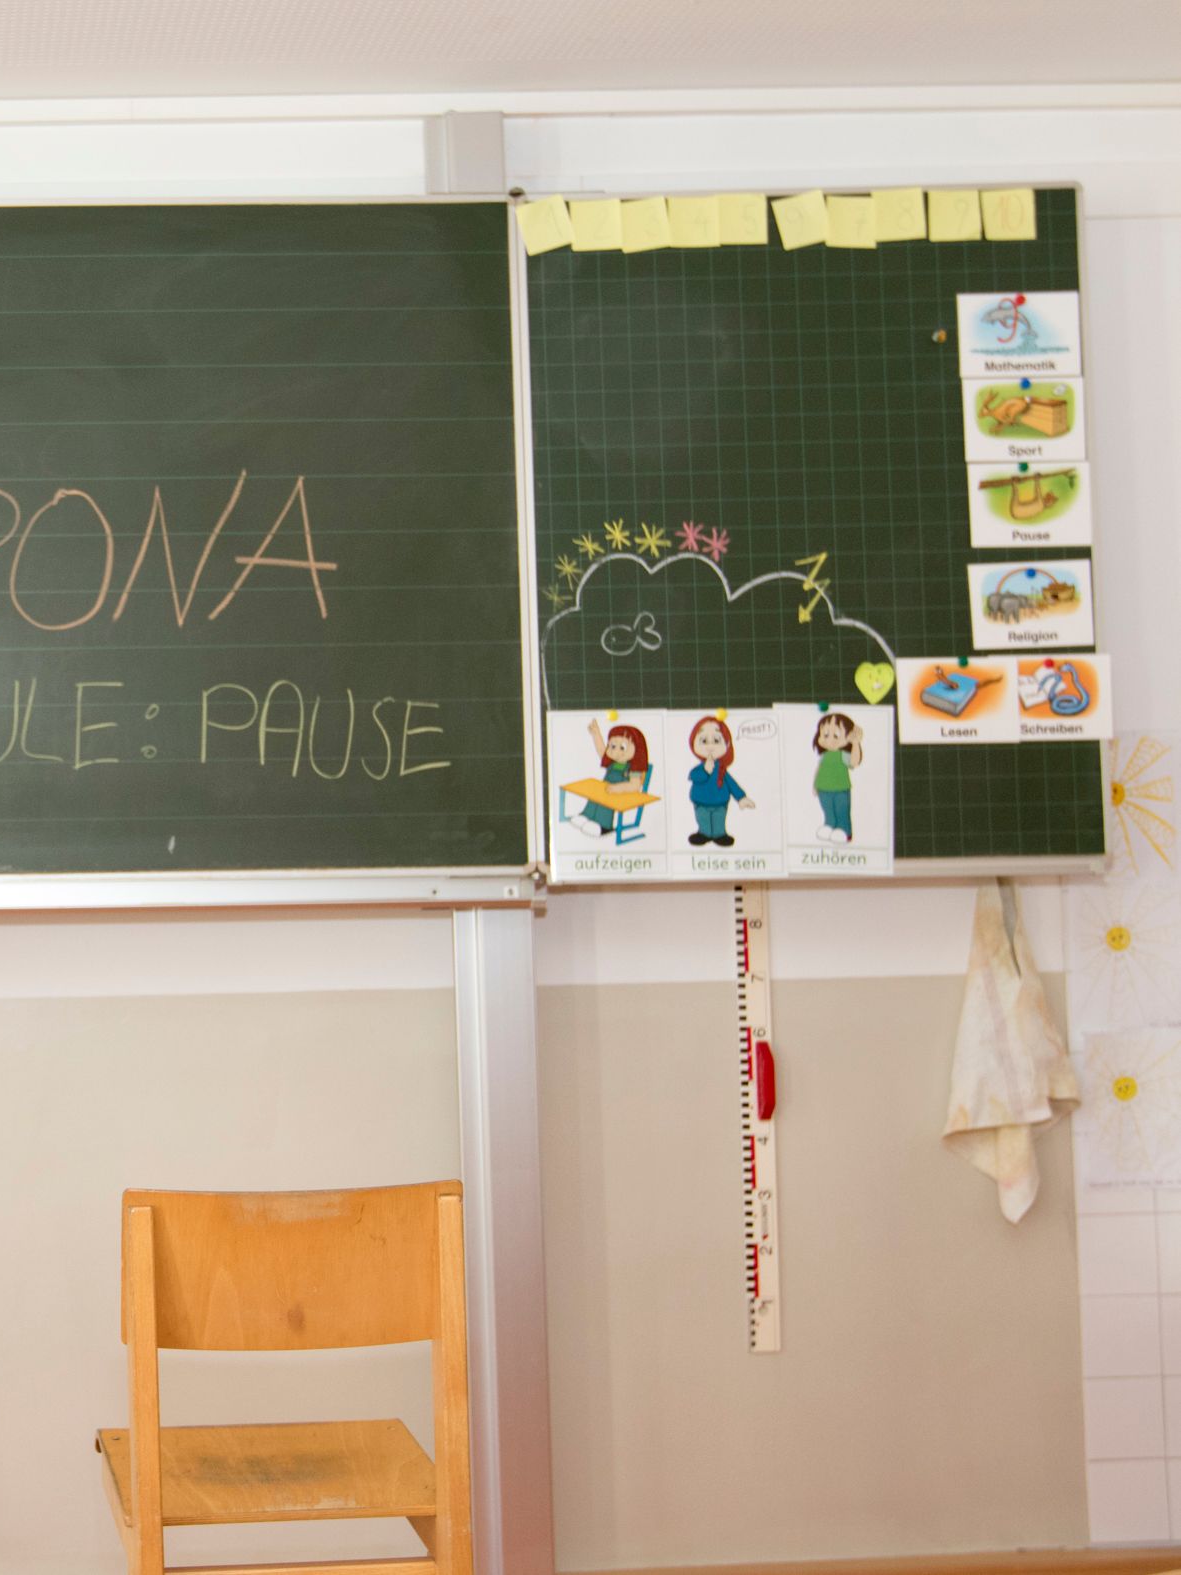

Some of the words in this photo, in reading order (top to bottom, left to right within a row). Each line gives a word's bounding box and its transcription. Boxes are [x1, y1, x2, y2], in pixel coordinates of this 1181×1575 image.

[741, 203, 758, 236] 5
[896, 195, 915, 231] 8
[954, 198, 970, 234] 9
[992, 193, 1025, 232] 10
[984, 361, 1056, 372] Mathematik
[1008, 445, 1043, 457] Sport
[1012, 530, 1051, 541] Pause
[1008, 629, 1059, 644] Religion
[201, 680, 451, 780] PAUSE
[940, 726, 978, 738] Lesen
[1020, 723, 1083, 736] Schreiben
[574, 855, 652, 873] aufzeigen
[691, 855, 729, 871] leise
[734, 855, 766, 871] sein
[801, 851, 867, 866] zuhören
